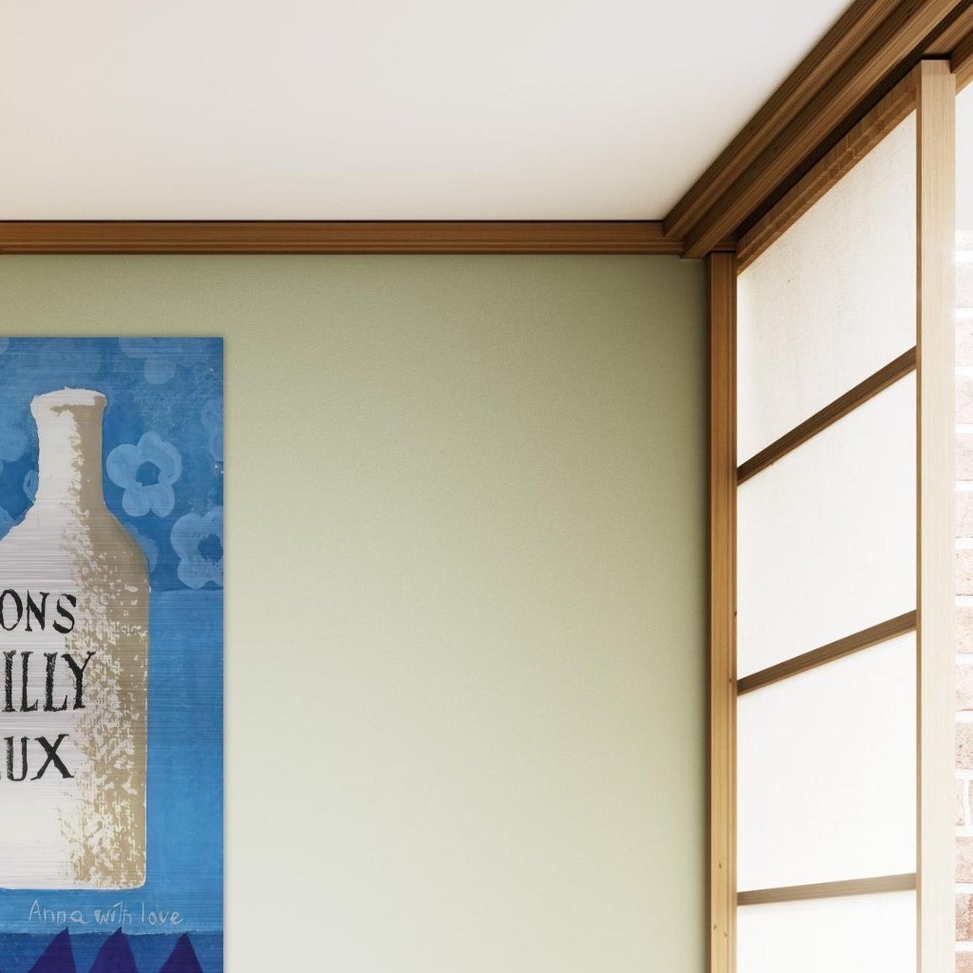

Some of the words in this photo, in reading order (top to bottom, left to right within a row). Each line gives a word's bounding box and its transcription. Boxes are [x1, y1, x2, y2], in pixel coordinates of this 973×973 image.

[28, 898, 90, 925] Anna
[93, 902, 133, 925] with
[141, 901, 184, 926] love
